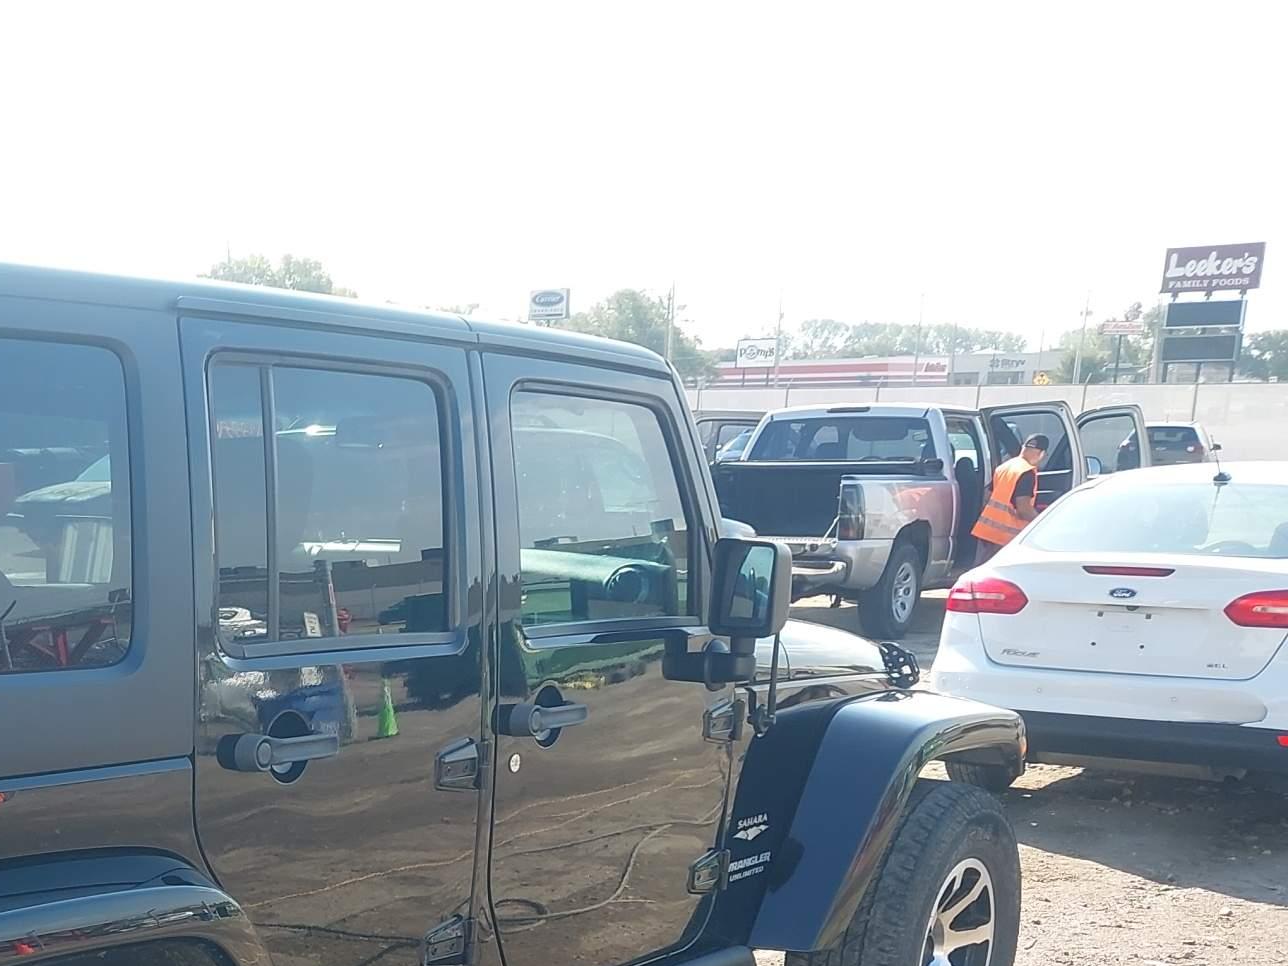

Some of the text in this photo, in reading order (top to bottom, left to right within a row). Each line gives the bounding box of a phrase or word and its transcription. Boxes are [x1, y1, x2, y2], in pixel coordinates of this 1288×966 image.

[1165, 252, 1258, 278] Leeker's
[1168, 277, 1250, 289] FAMILY FOODS
[737, 813, 768, 829] SAHARA
